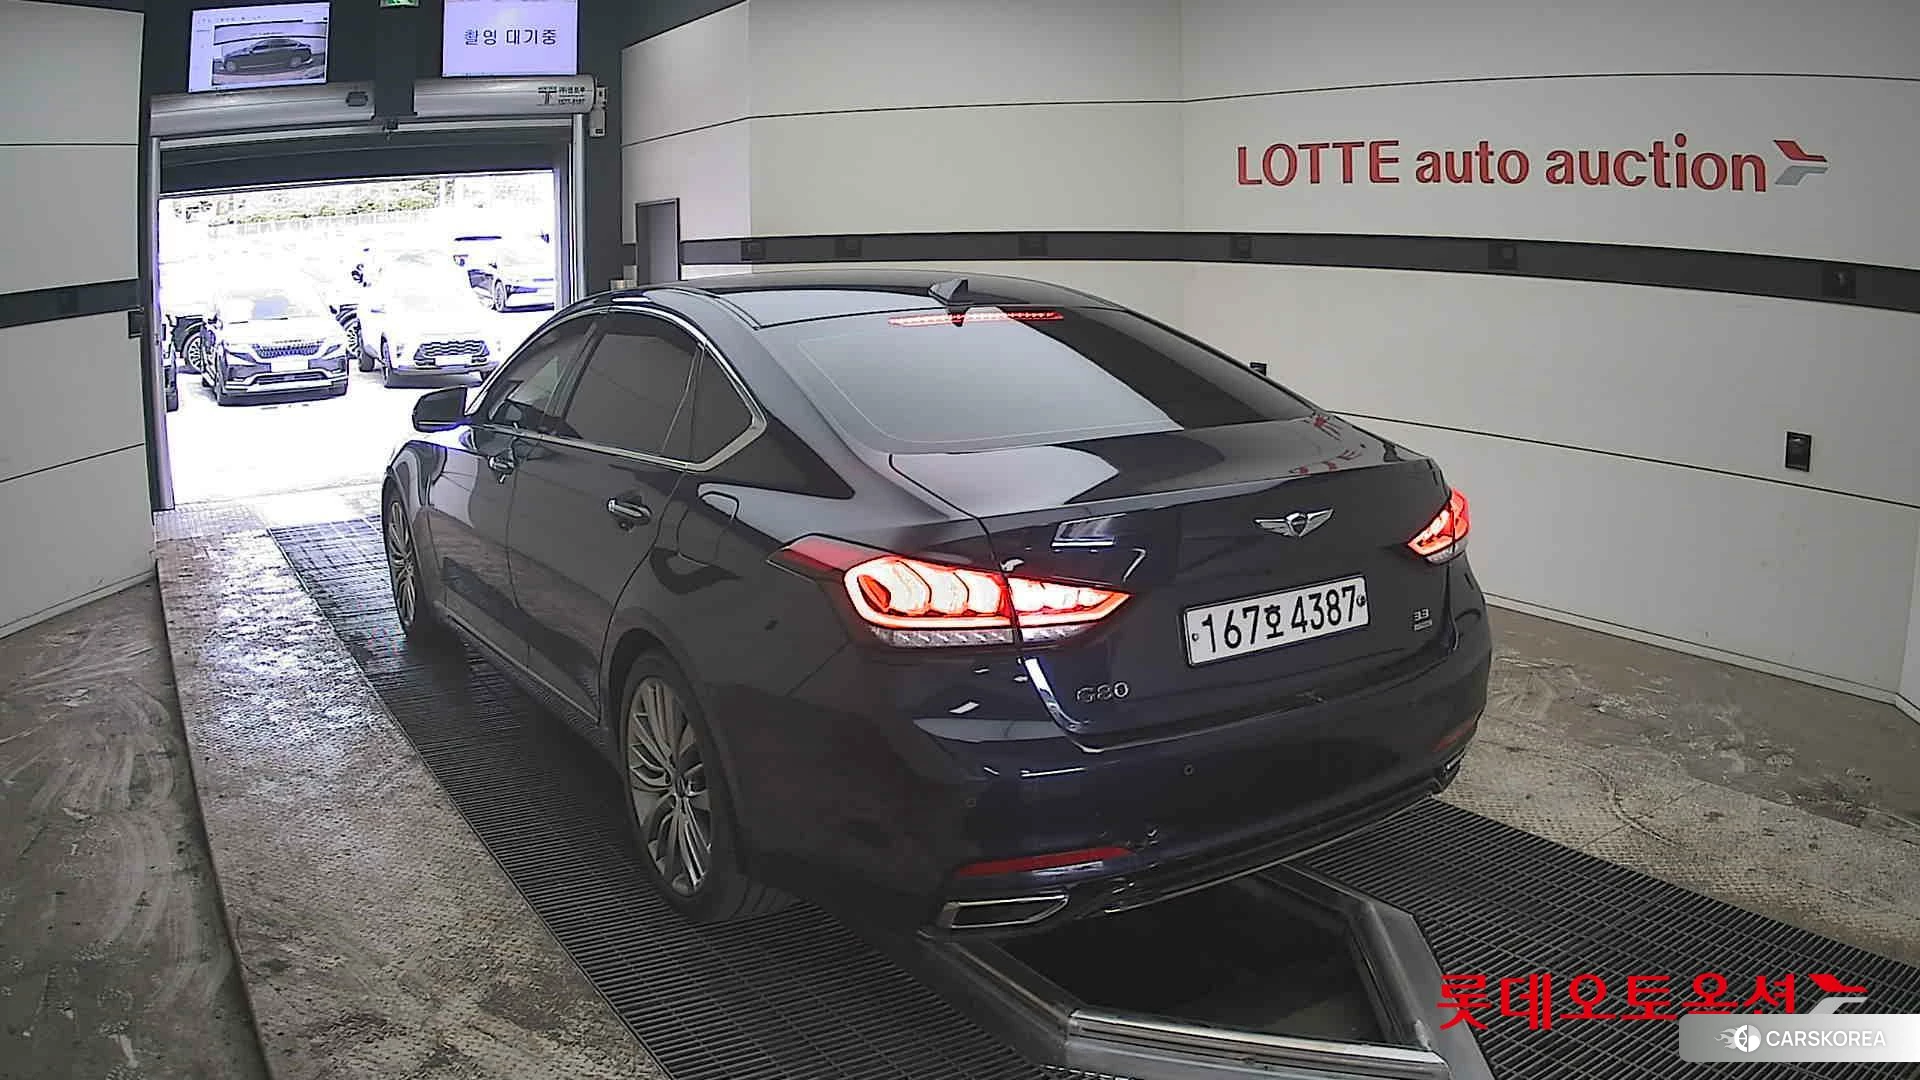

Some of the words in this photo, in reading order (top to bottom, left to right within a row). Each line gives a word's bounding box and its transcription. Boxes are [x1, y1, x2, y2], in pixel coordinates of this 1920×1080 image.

[506, 28, 556, 46] 대기중
[1237, 139, 1400, 185] LOTTE
[1415, 139, 1530, 185] auto
[1545, 132, 1767, 192] auction
[1201, 604, 1284, 653] 167호
[1291, 584, 1356, 633] 4387
[1076, 681, 1130, 703] G80
